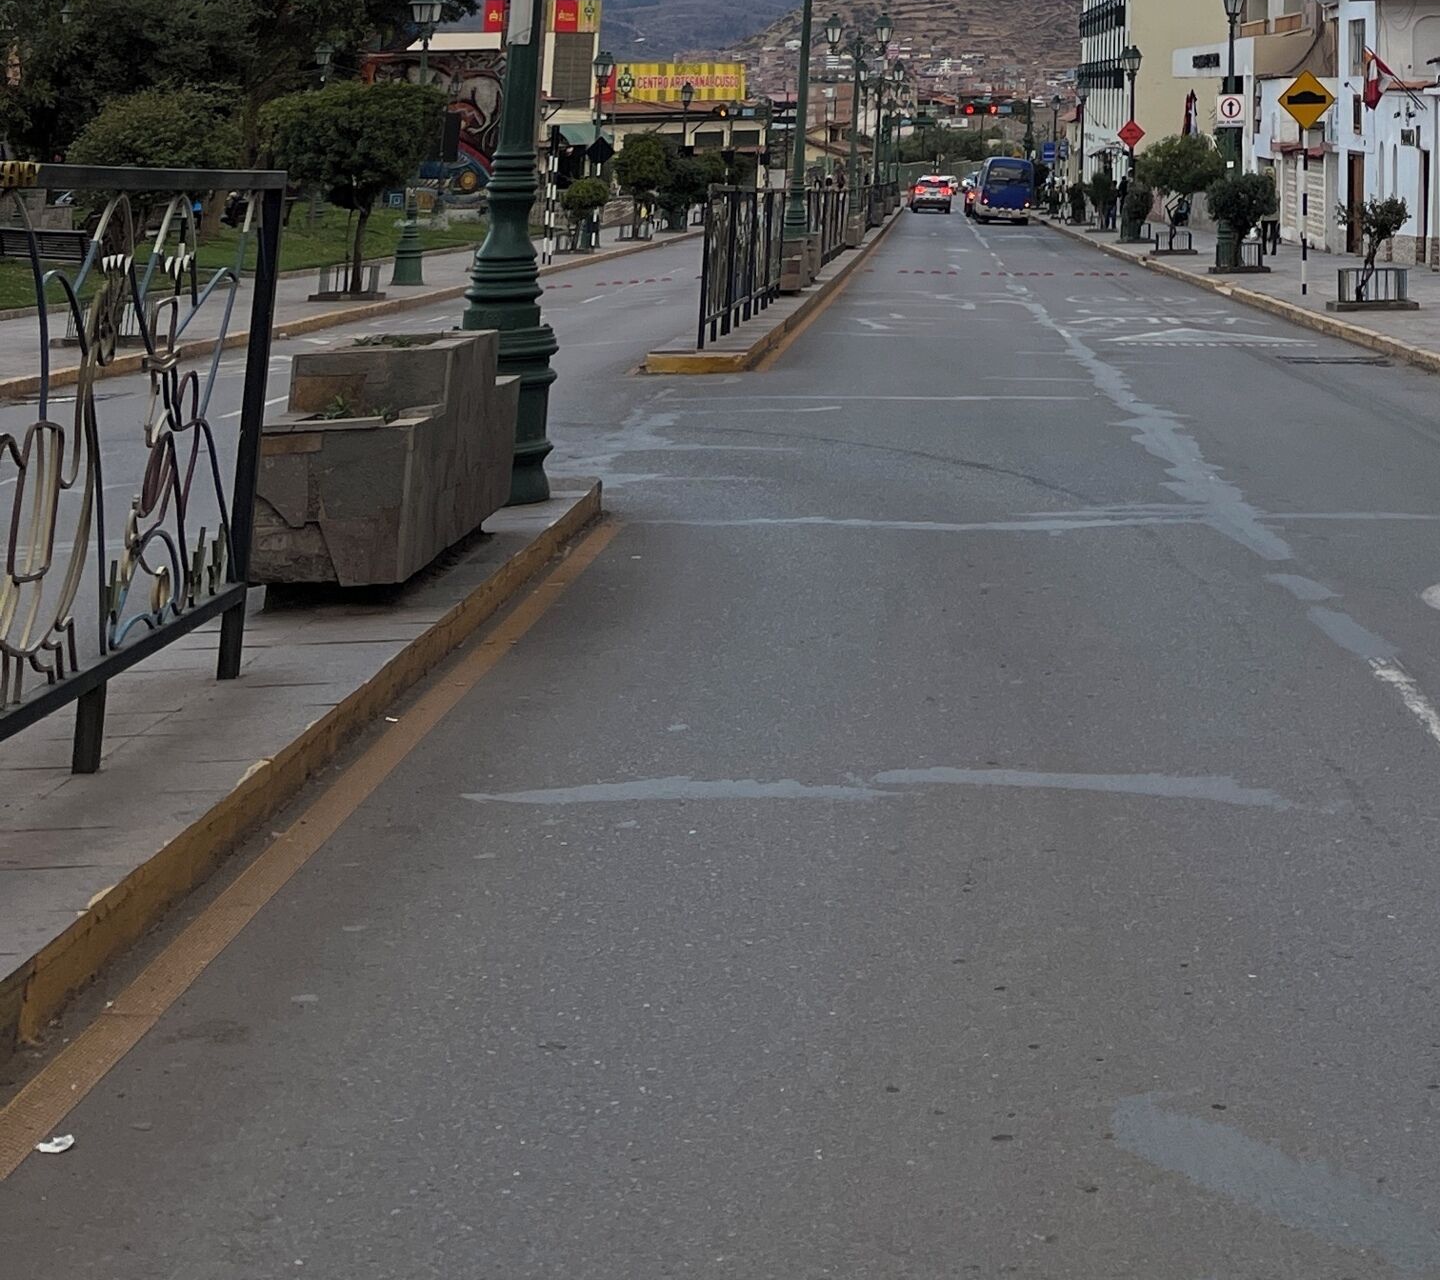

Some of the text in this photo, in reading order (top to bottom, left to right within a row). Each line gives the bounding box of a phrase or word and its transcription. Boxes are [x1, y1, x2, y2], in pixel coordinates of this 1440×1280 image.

[636, 75, 740, 89] CENTRO ARTESANAL CUSCO
